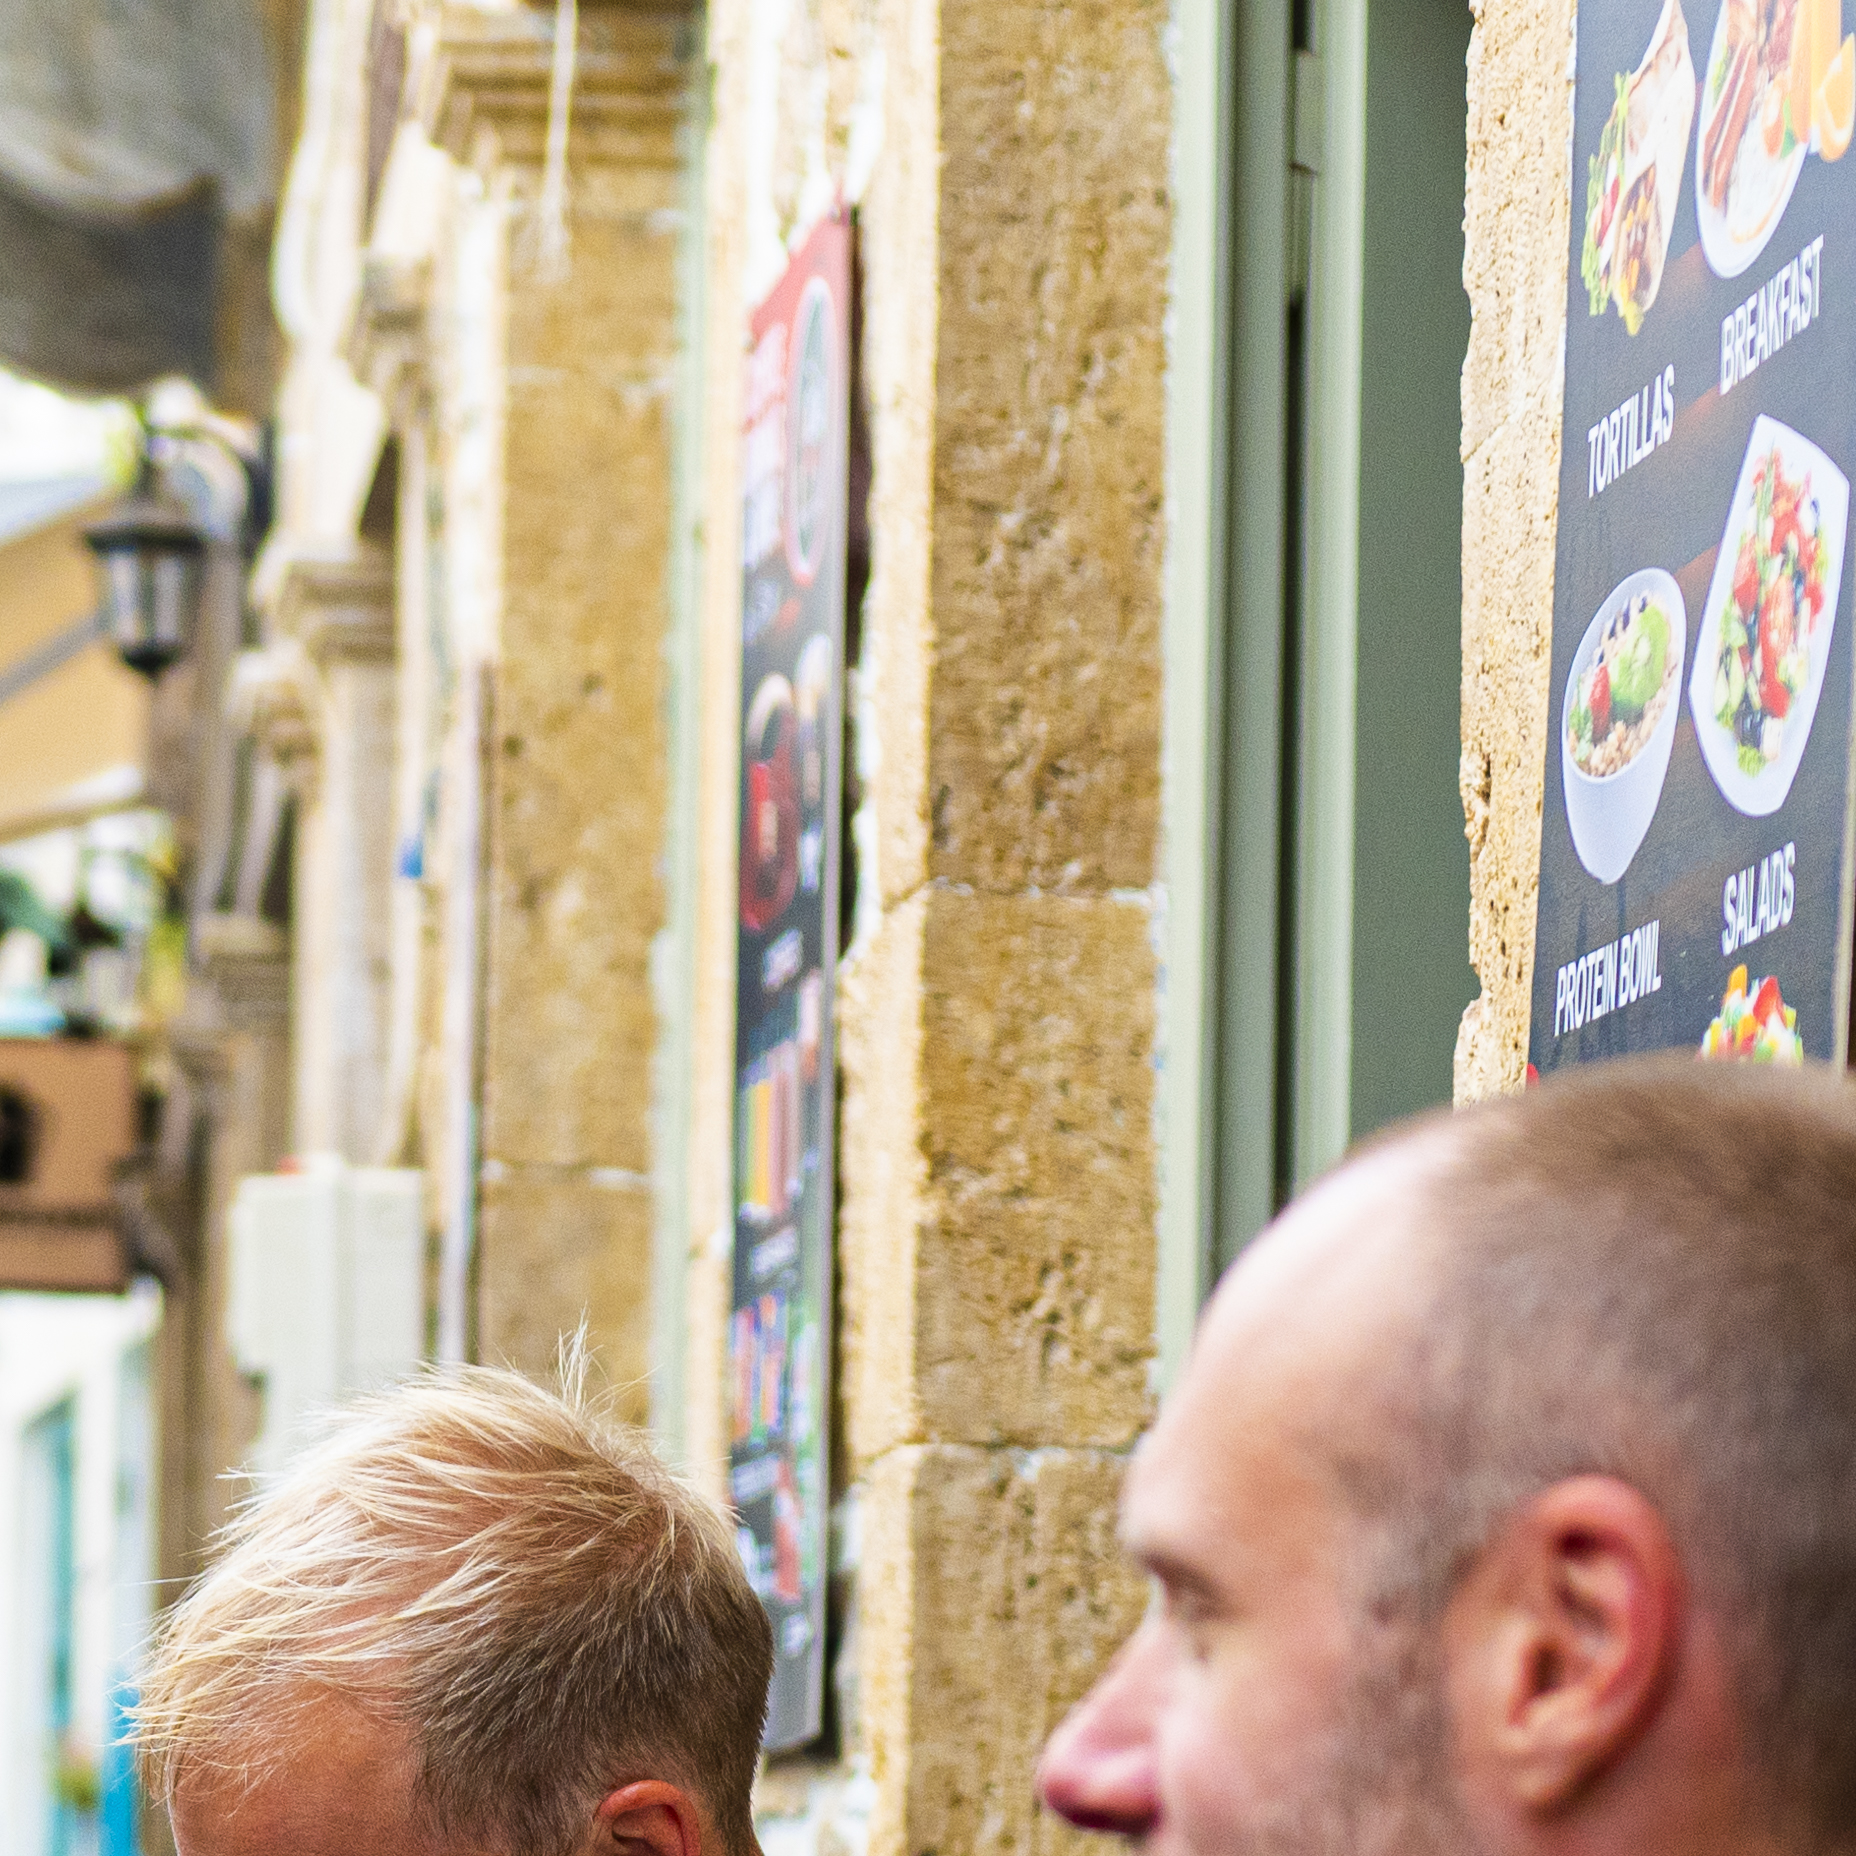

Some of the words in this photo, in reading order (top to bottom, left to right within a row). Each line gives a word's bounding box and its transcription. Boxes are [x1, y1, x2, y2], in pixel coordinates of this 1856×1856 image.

[1720, 234, 1824, 396] BREAKFAST
[1588, 364, 1675, 499] TORTILLAS
[1721, 841, 1796, 956] SALADS
[1554, 941, 1619, 1037] PROTEIN
[1618, 920, 1662, 1009] BOWL
